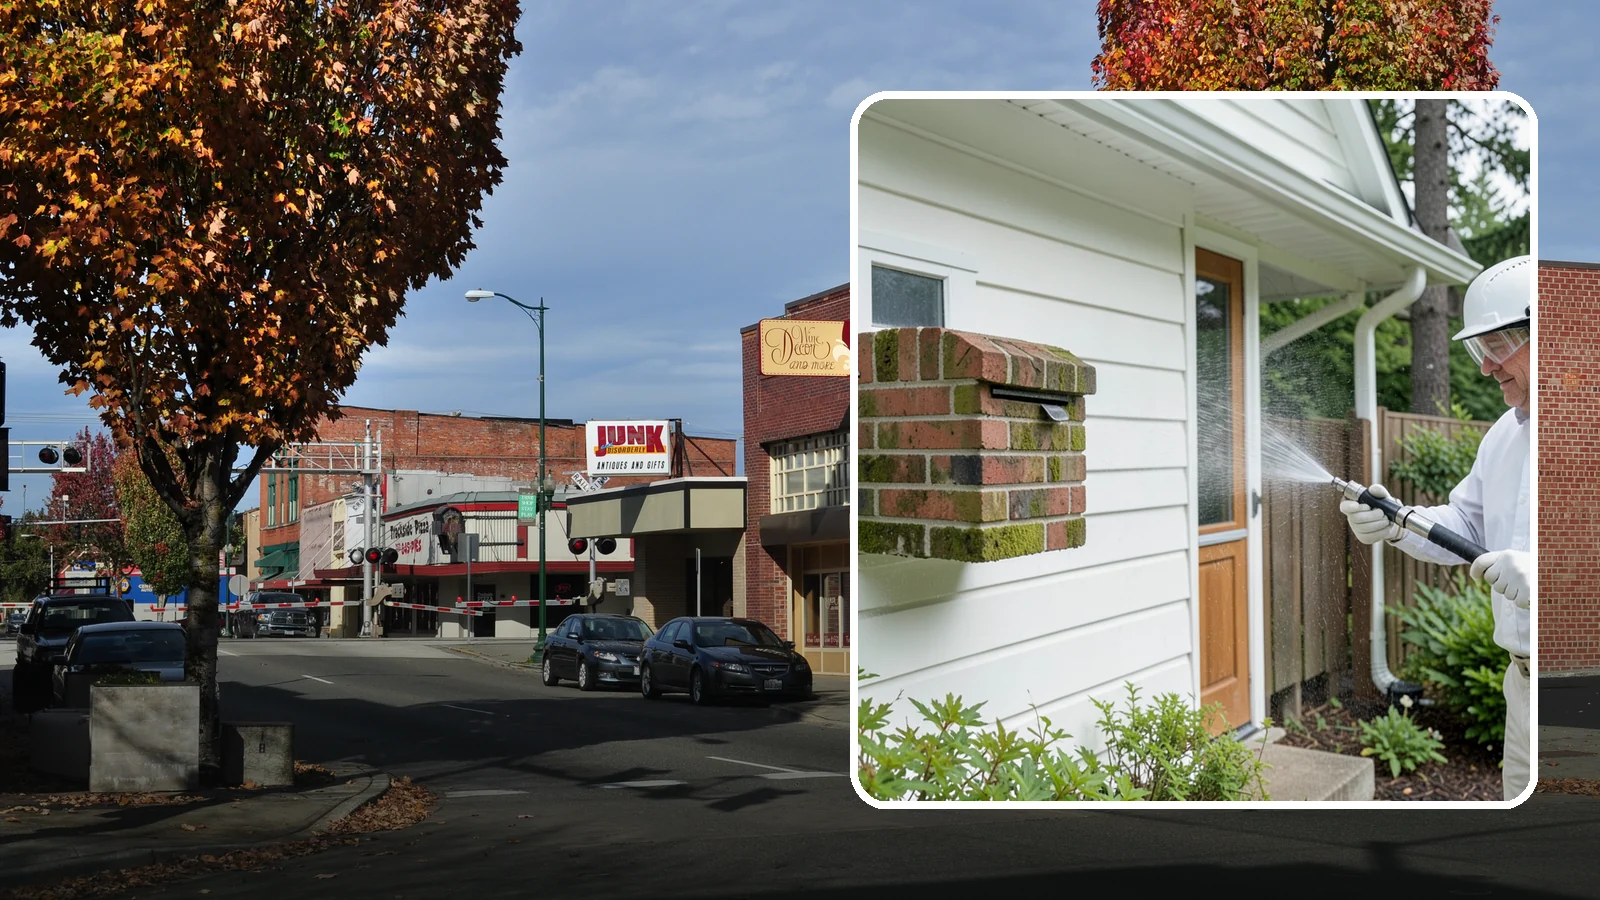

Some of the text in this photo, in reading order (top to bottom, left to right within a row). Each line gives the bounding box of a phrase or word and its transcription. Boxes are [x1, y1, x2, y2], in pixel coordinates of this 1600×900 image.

[595, 425, 665, 457] JUNK
[597, 460, 665, 470] ANTIQUES AND GIFTS
